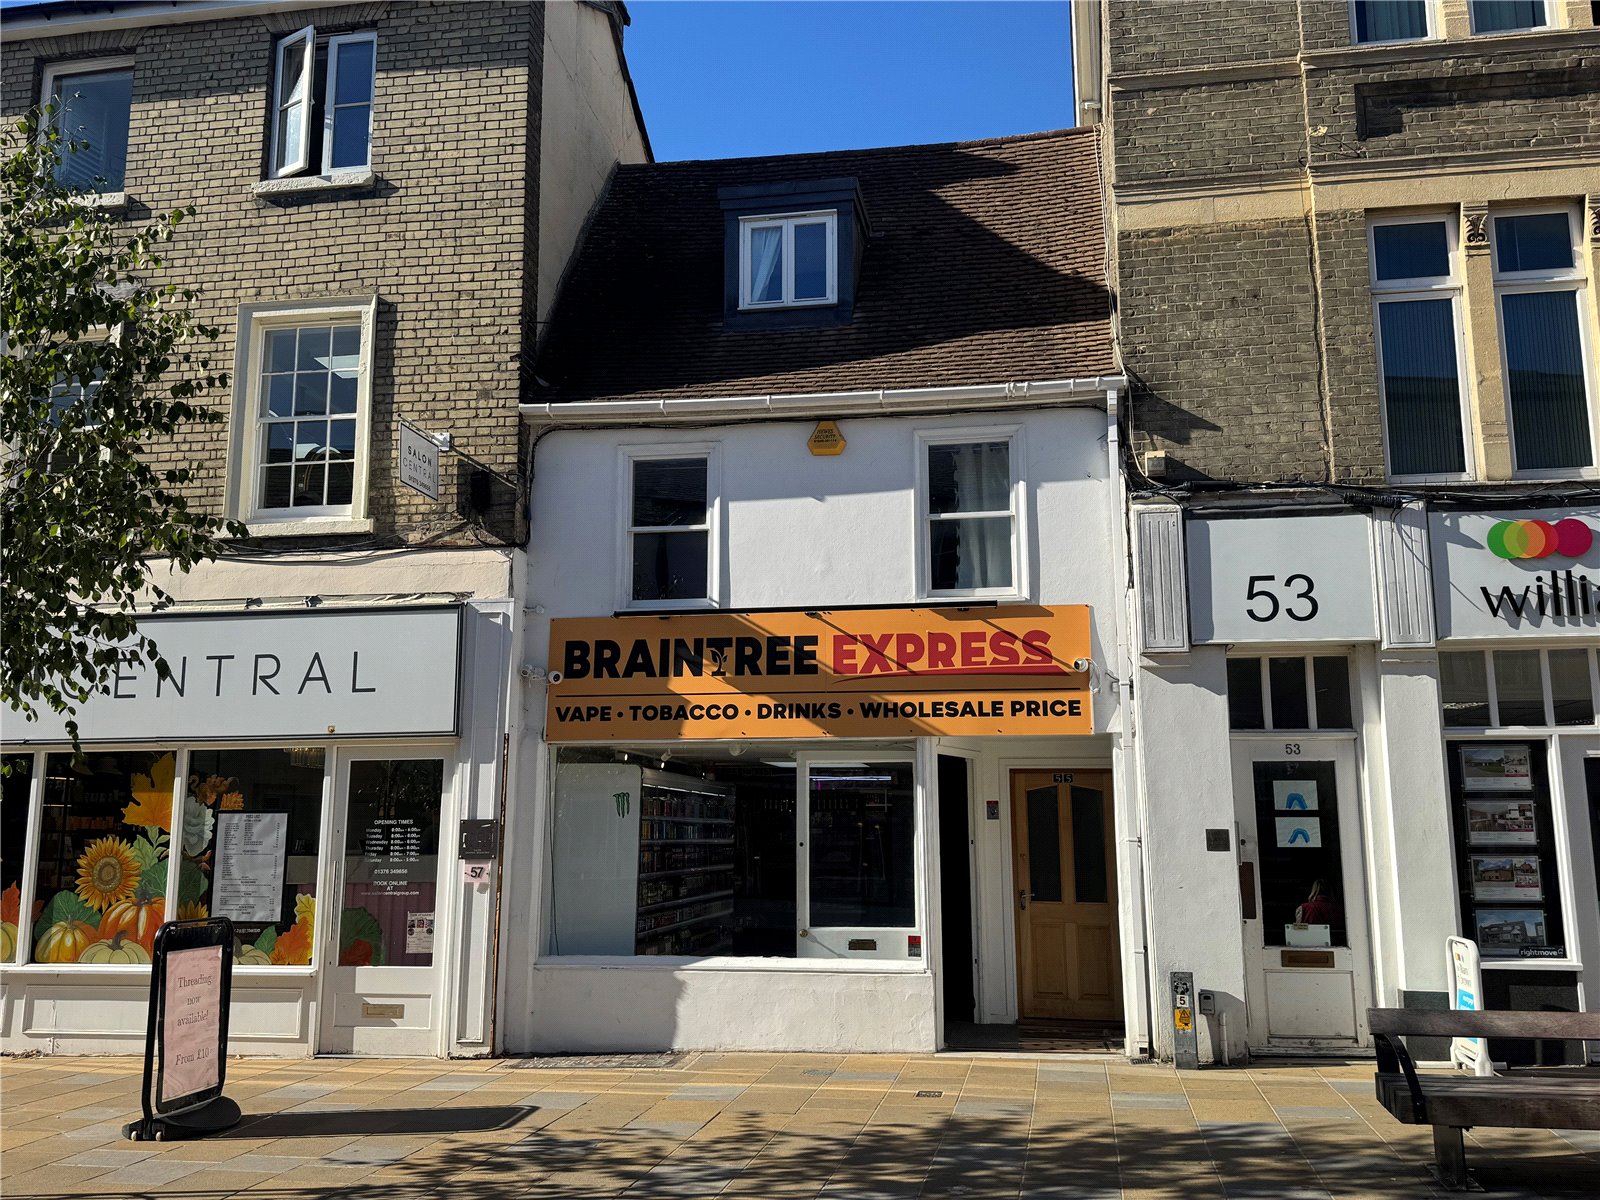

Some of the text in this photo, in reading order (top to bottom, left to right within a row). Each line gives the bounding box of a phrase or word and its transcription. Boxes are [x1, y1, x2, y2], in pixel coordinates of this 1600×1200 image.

[408, 446, 432, 467] SALON
[403, 457, 436, 483] CENTRAL
[1246, 574, 1318, 622] 53
[1480, 570, 1600, 618] willi
[563, 630, 1053, 679] BRAINTREE EXPRESS
[556, 700, 1082, 722] VAPE TOBACCO DRINKS WHOLESALE PRICE
[1285, 744, 1301, 755] 53
[1054, 774, 1072, 783] 55
[471, 867, 483, 878] 57
[178, 974, 212, 988] Threading
[187, 996, 201, 1005] now
[1180, 997, 1185, 1005] 5
[177, 1010, 209, 1026] available!
[175, 1053, 194, 1065] From
